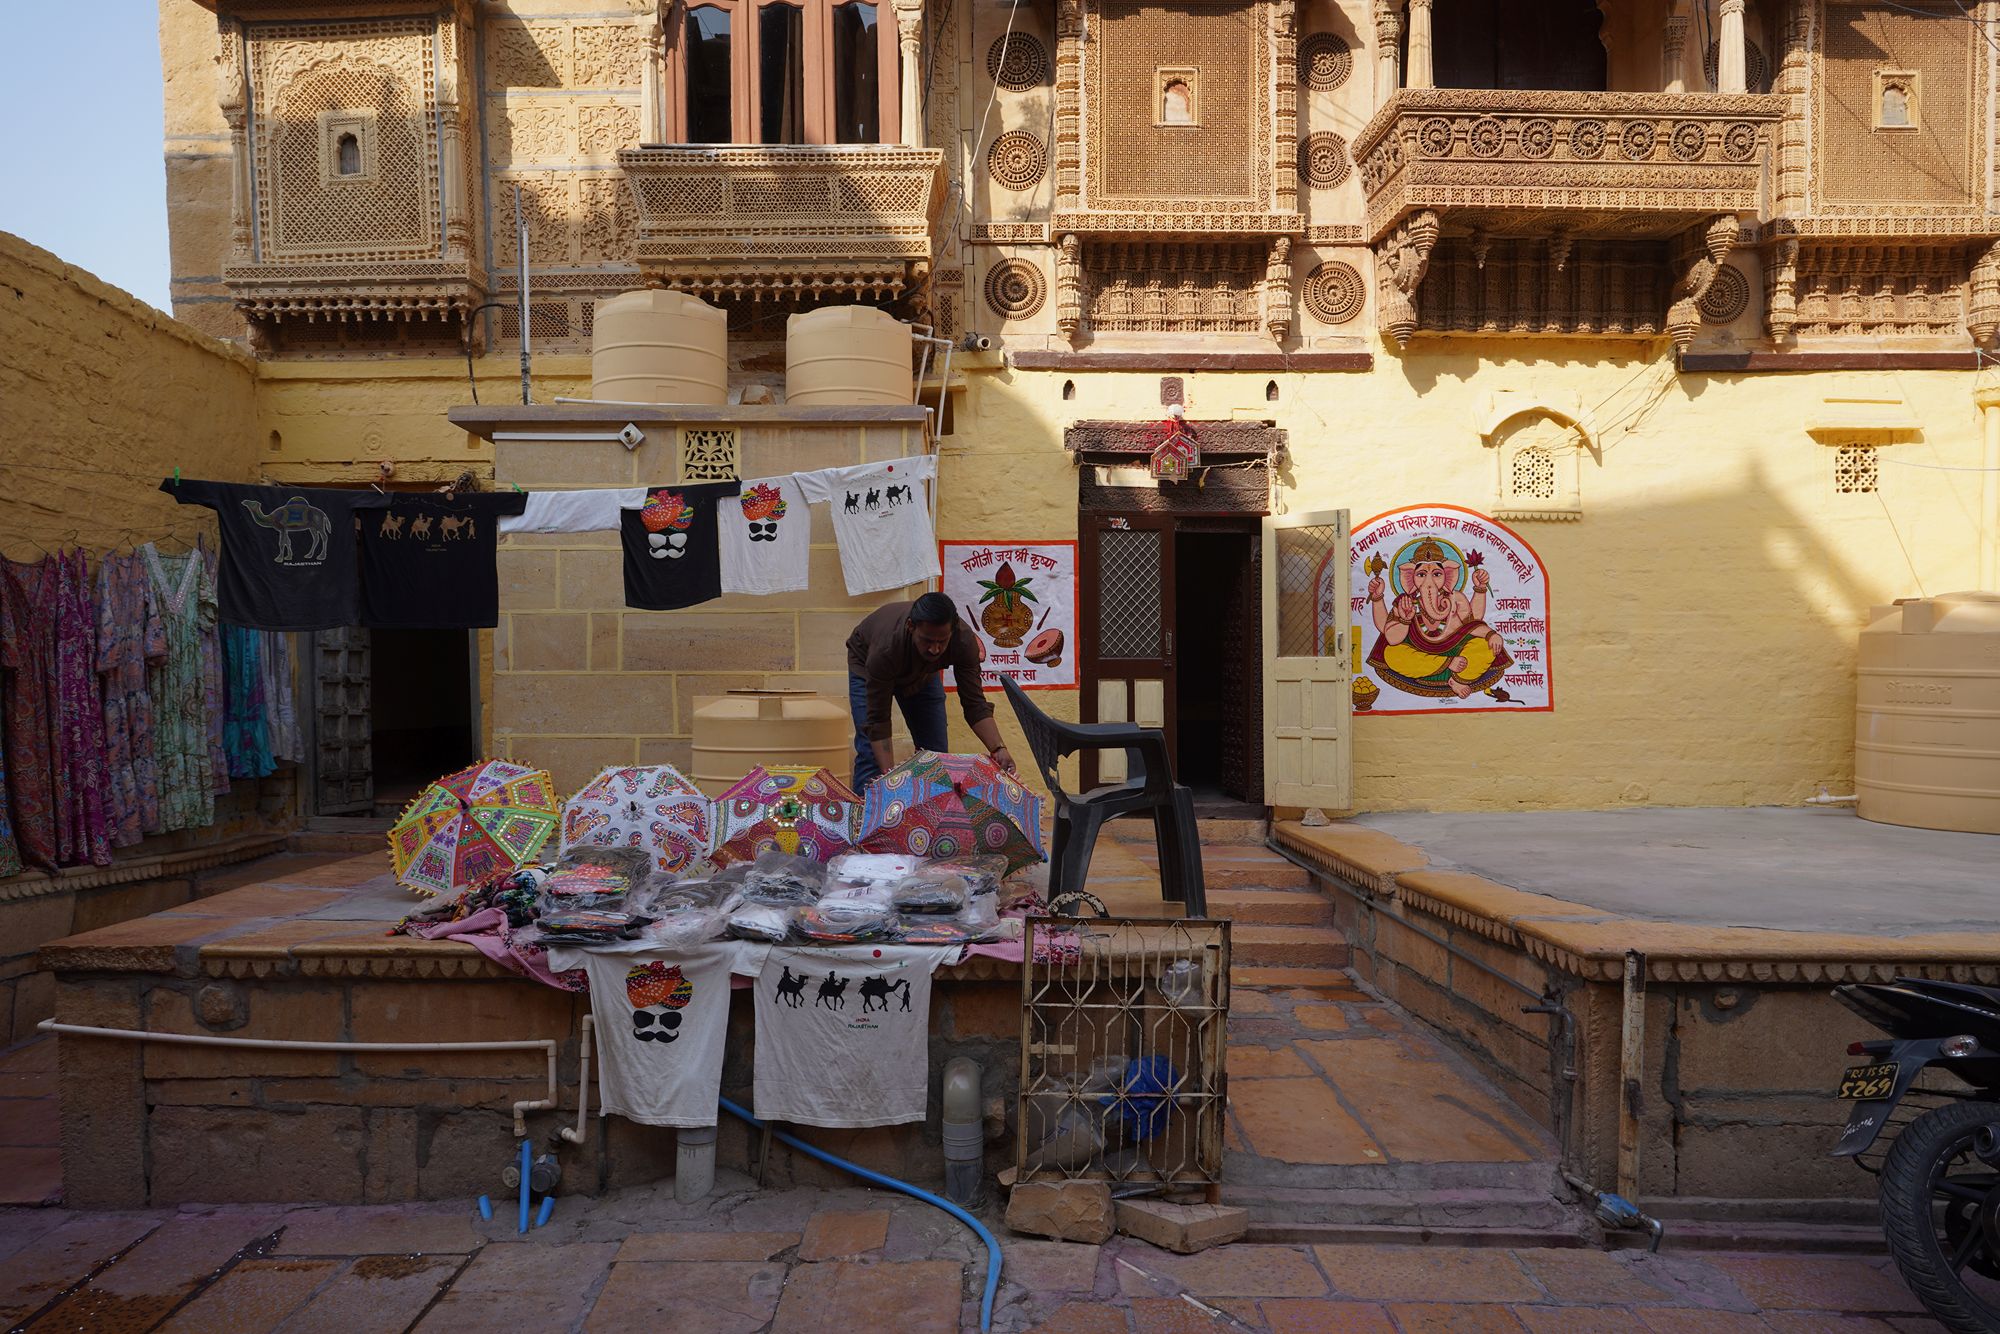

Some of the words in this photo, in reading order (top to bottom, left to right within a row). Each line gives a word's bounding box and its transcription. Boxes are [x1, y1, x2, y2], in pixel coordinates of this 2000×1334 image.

[1376, 520, 1398, 538] भाटी
[1396, 515, 1429, 531] परिवार
[1429, 515, 1460, 531] आपका
[1461, 519, 1487, 540] हार्दिक
[1485, 532, 1509, 554] स्वागत
[995, 550, 1013, 562] जय
[1015, 547, 1029, 564] श्री
[1030, 553, 1058, 571] कृष्ण
[990, 649, 1021, 666] सगाजी
[1513, 646, 1540, 662] गायत्री
[1022, 670, 1037, 681] सा
[1839, 1078, 1891, 1098] 5269
